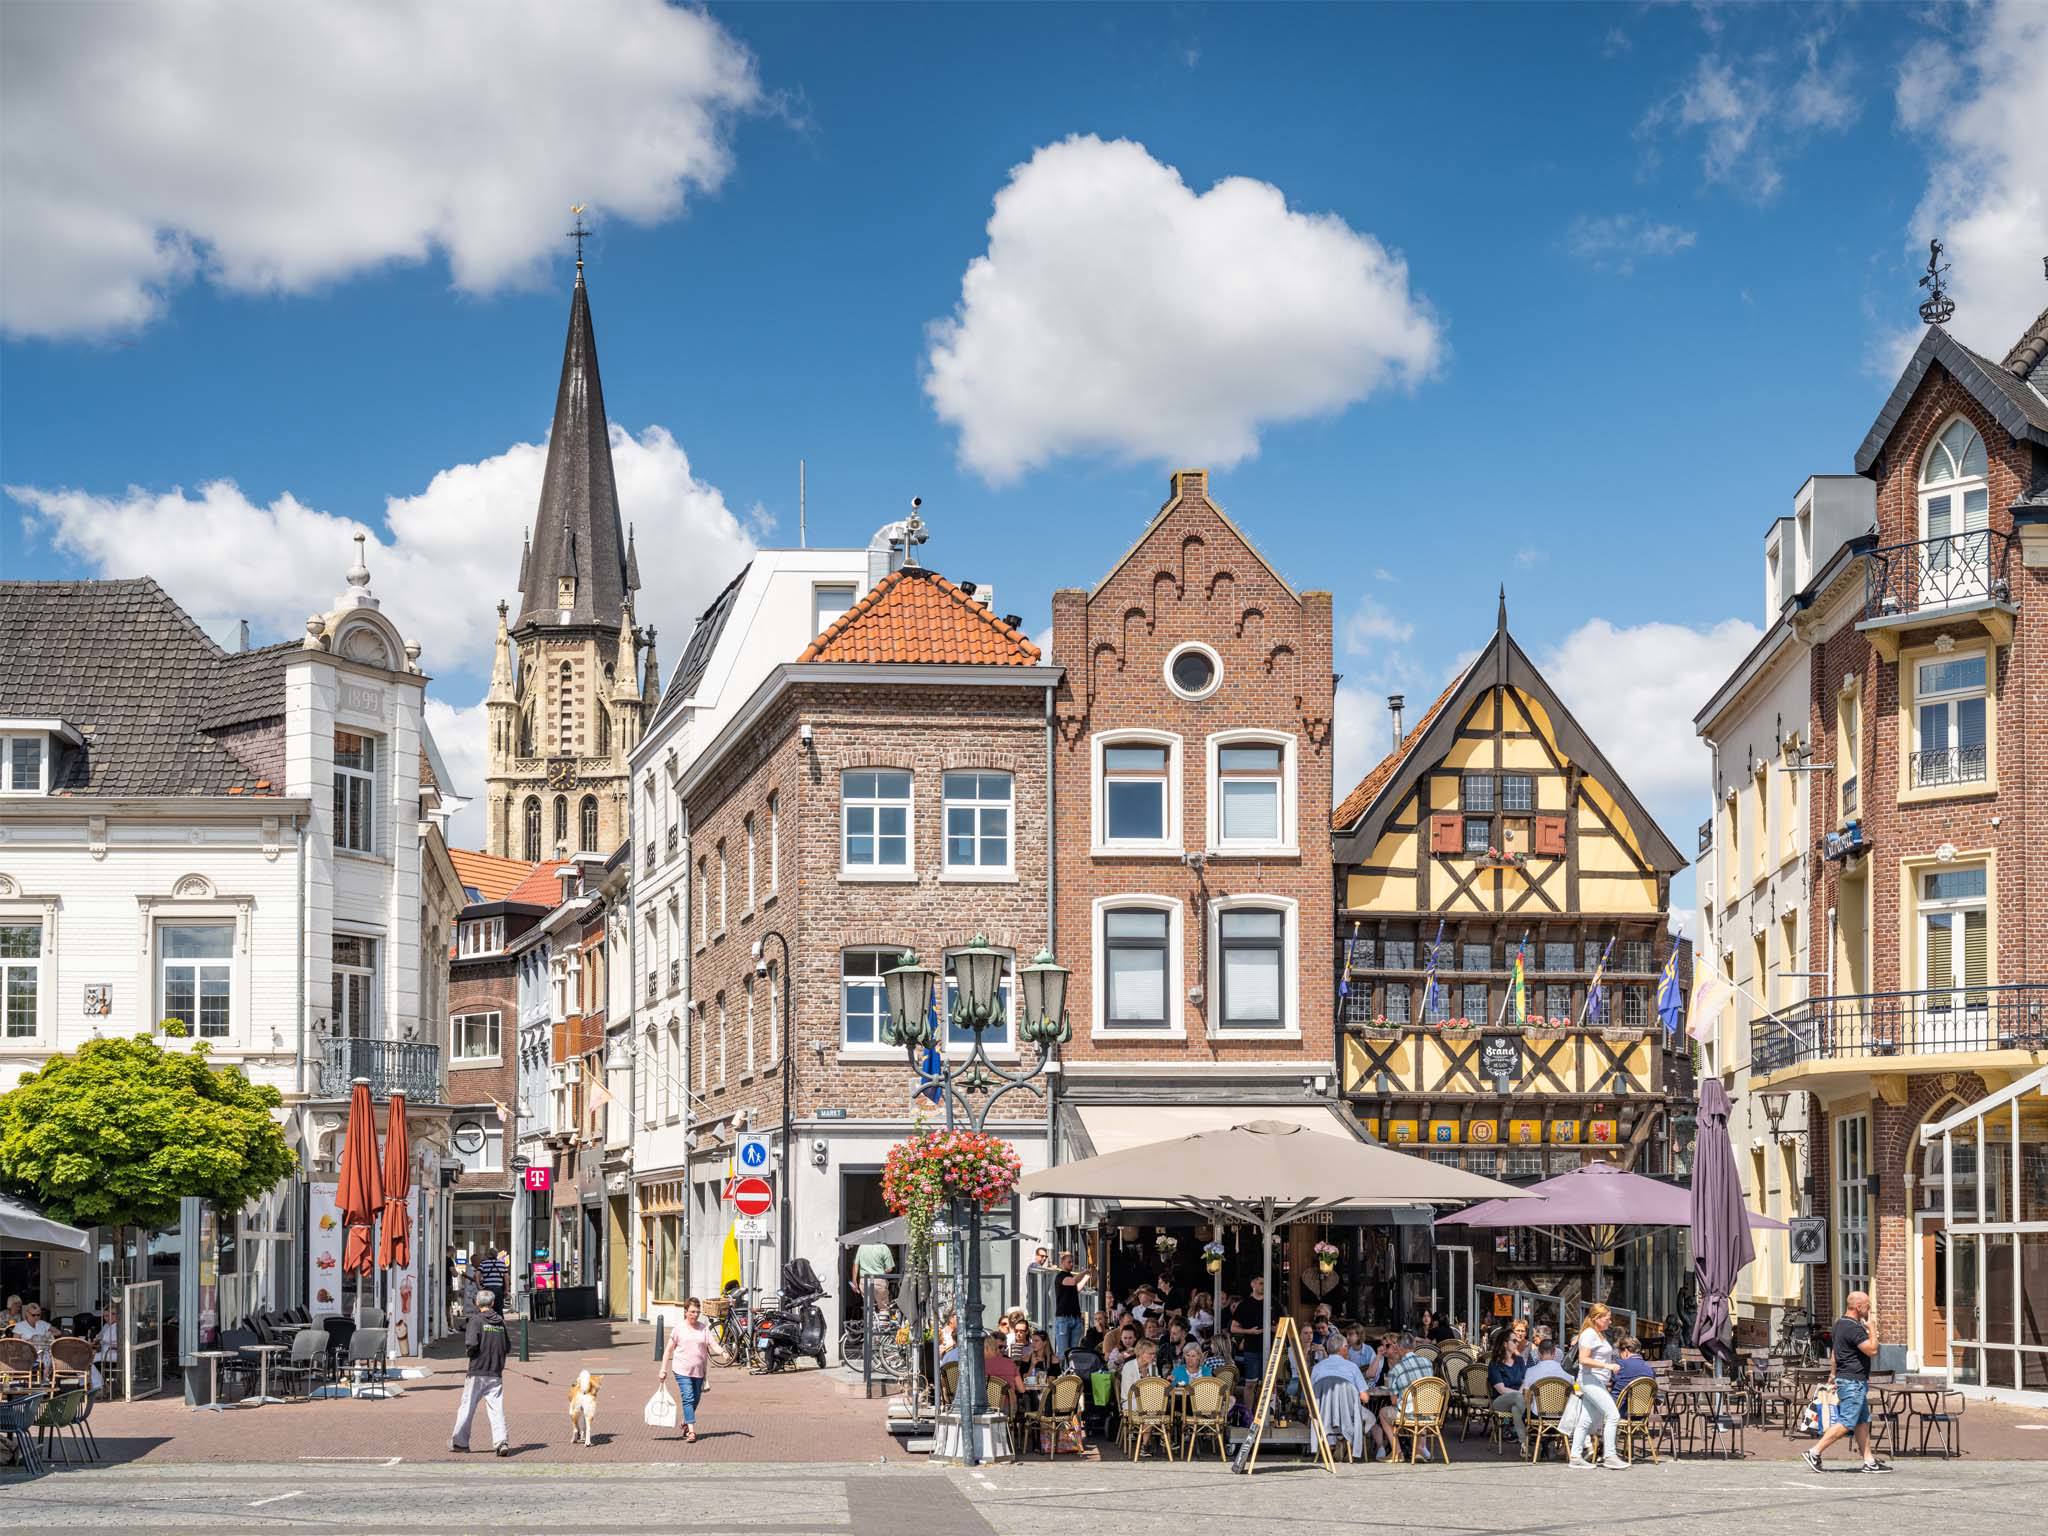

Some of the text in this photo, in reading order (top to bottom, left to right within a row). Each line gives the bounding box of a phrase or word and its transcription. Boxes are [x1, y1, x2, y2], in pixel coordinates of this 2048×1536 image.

[348, 689, 378, 711] 1899
[1486, 1046, 1515, 1057] Brand
[820, 1109, 842, 1117] MARKT
[530, 1170, 545, 1187] T
